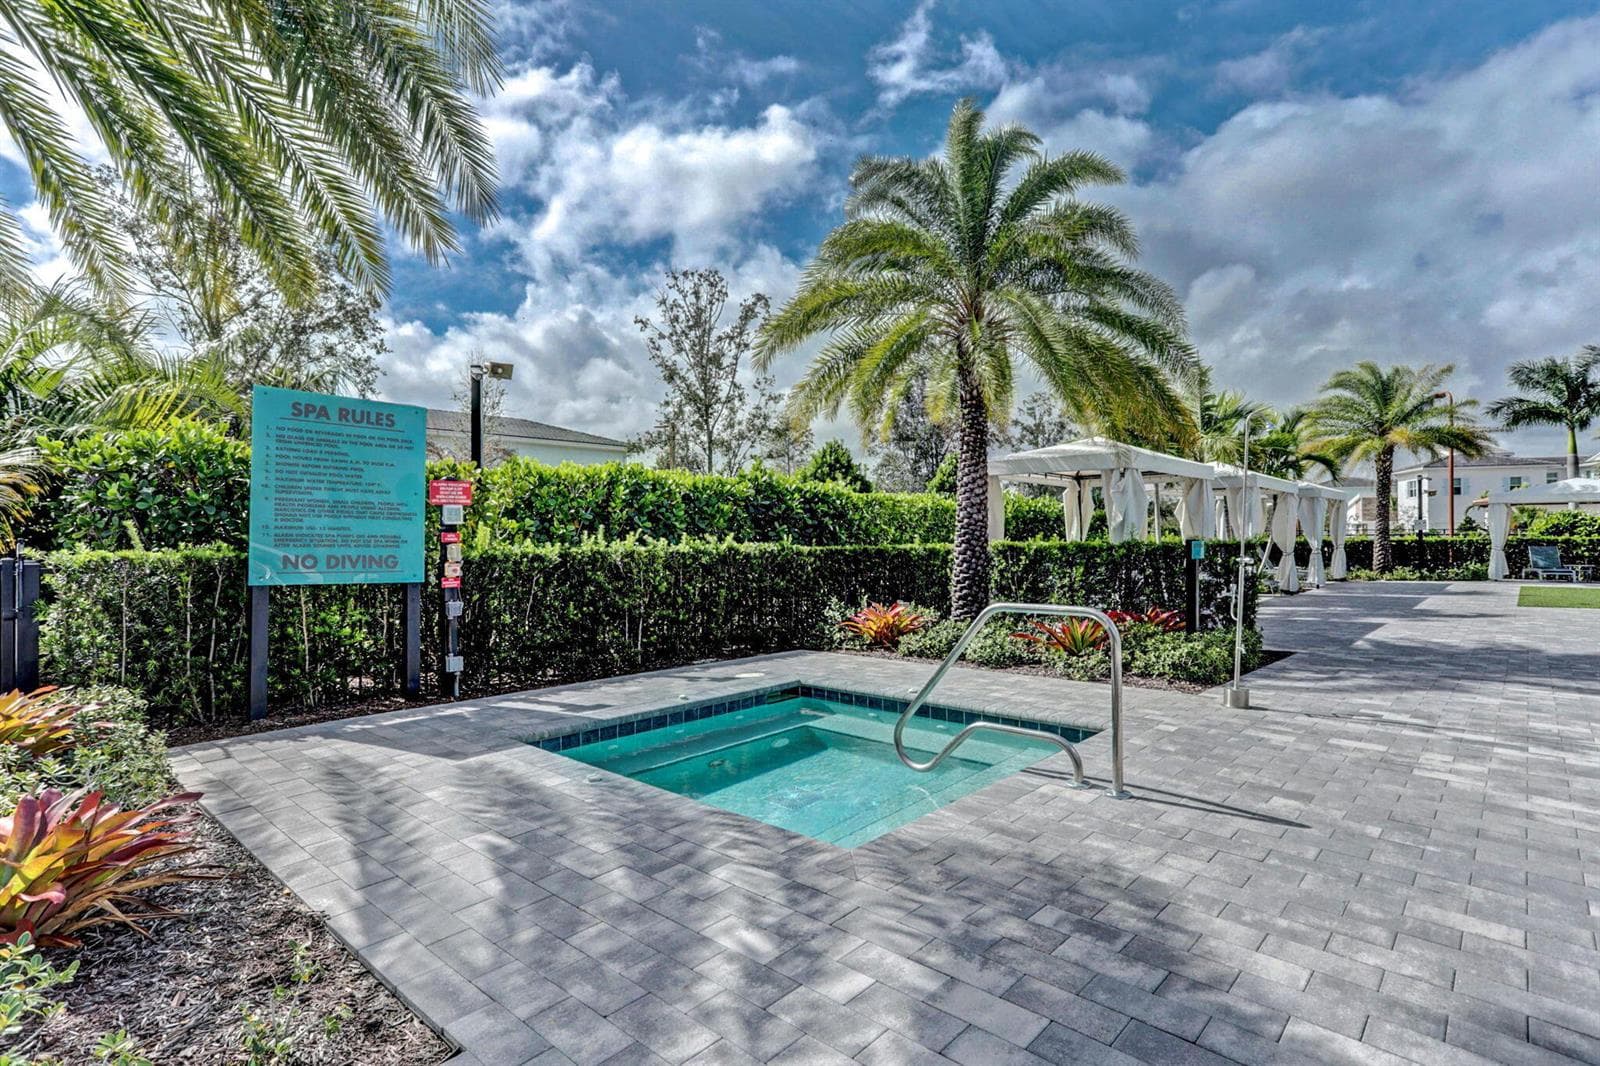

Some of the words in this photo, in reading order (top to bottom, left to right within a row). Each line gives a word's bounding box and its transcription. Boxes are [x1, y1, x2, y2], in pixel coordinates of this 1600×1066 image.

[291, 401, 331, 420] SPA
[338, 407, 396, 428] RULES
[282, 554, 318, 570] NO
[326, 554, 399, 569] DIVING
